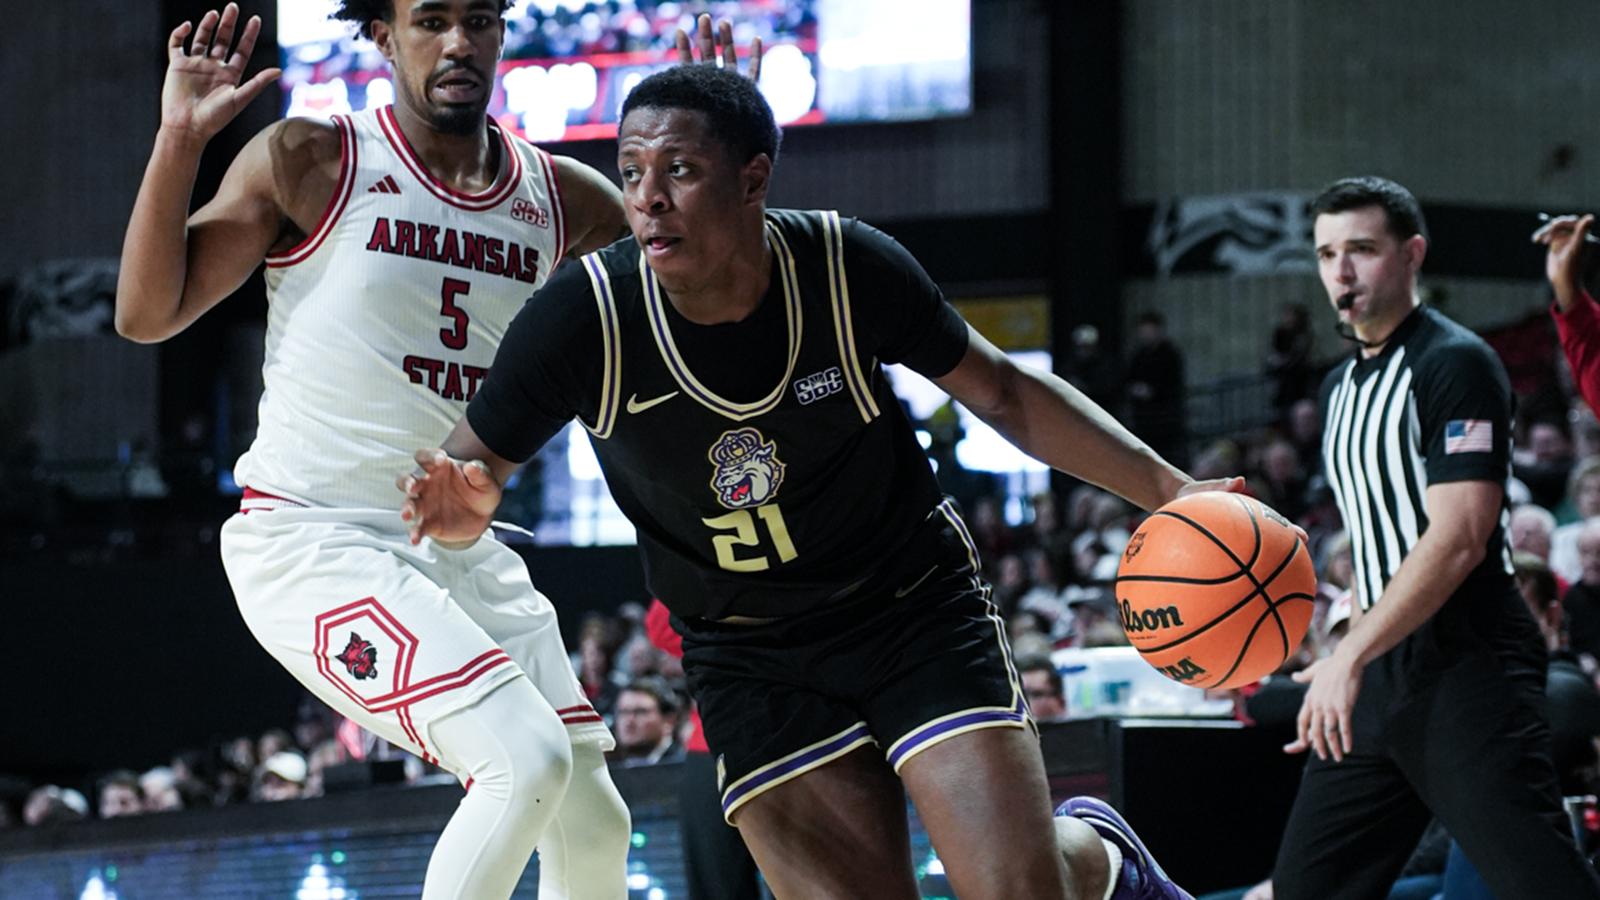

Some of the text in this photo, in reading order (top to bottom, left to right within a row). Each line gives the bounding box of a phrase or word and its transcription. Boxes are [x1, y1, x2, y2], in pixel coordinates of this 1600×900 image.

[366, 217, 539, 284] ARKANSAS
[439, 277, 470, 350] 5
[403, 354, 489, 402] STAT
[793, 366, 843, 405] SBC
[702, 503, 798, 572] 21
[1118, 598, 1184, 633] lson
[1156, 656, 1206, 682] AA
